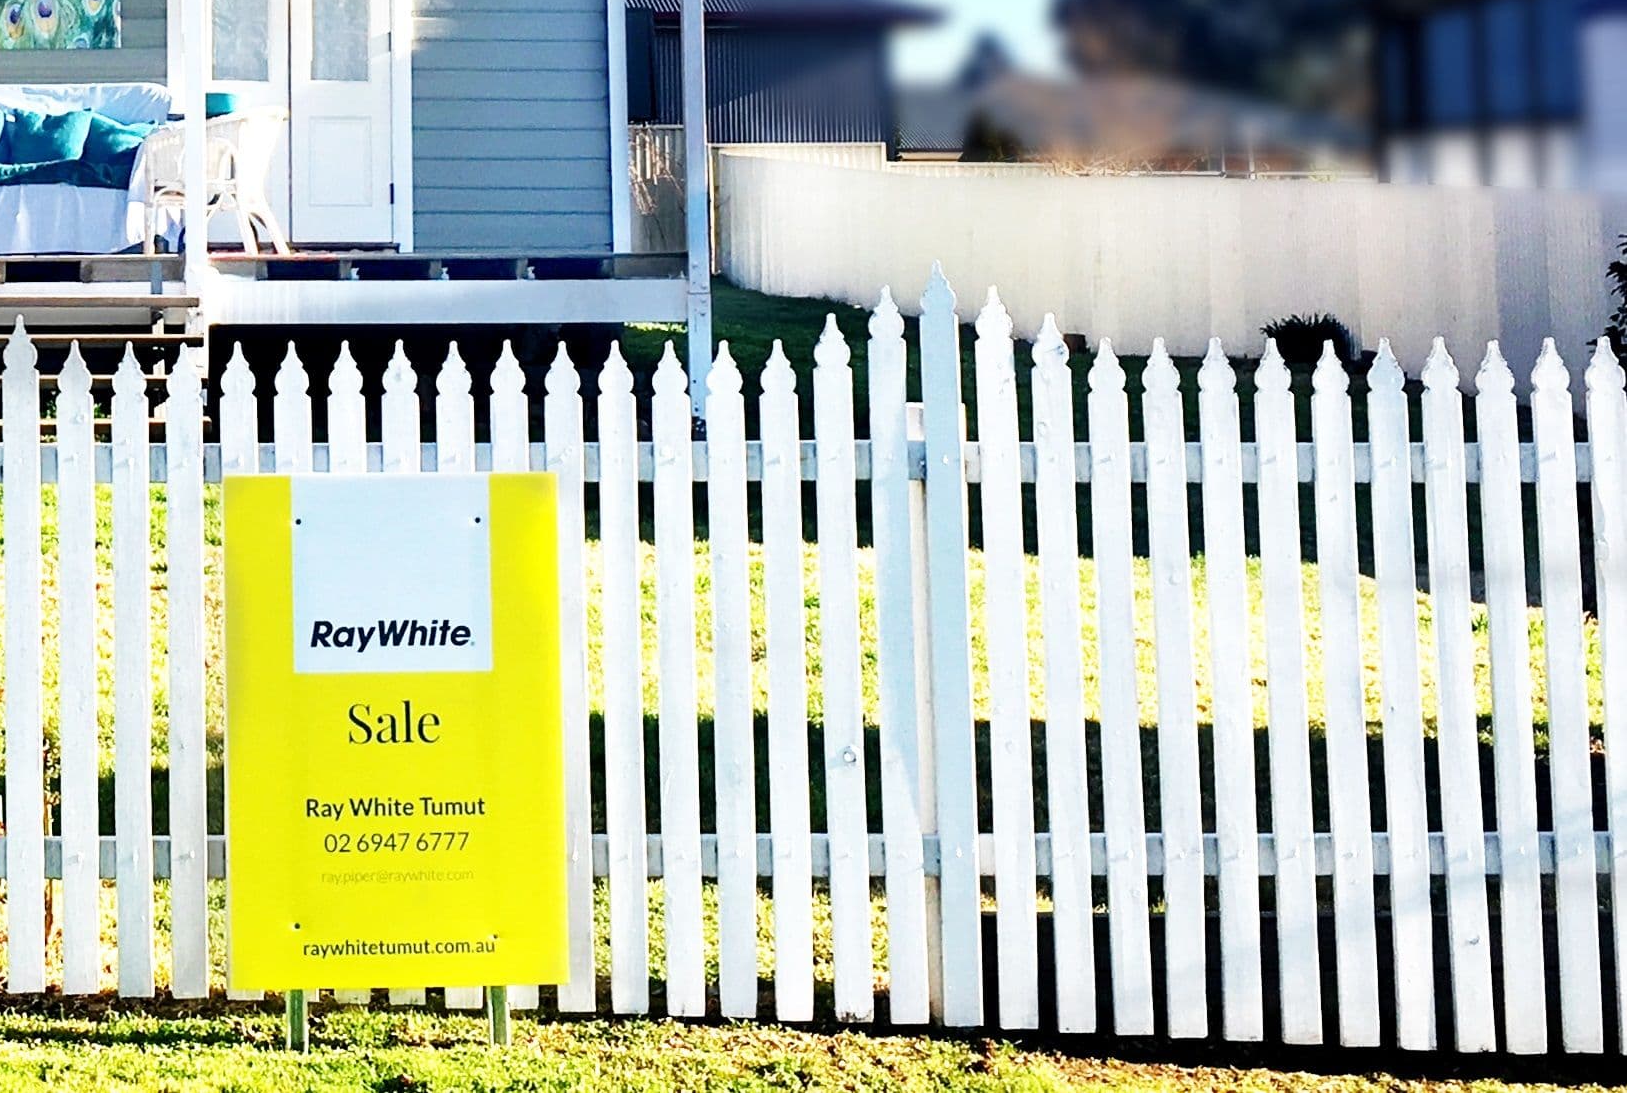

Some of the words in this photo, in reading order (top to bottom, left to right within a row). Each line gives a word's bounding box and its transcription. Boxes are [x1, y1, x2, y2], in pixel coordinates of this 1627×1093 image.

[348, 700, 440, 744] Sale
[306, 798, 344, 821] Ray
[349, 797, 414, 817] White
[419, 797, 485, 815] Tumut
[324, 833, 351, 853] 02
[356, 832, 410, 852] 6947
[416, 831, 469, 851] 6777
[303, 939, 495, 958] raywhitetumut.com.au
